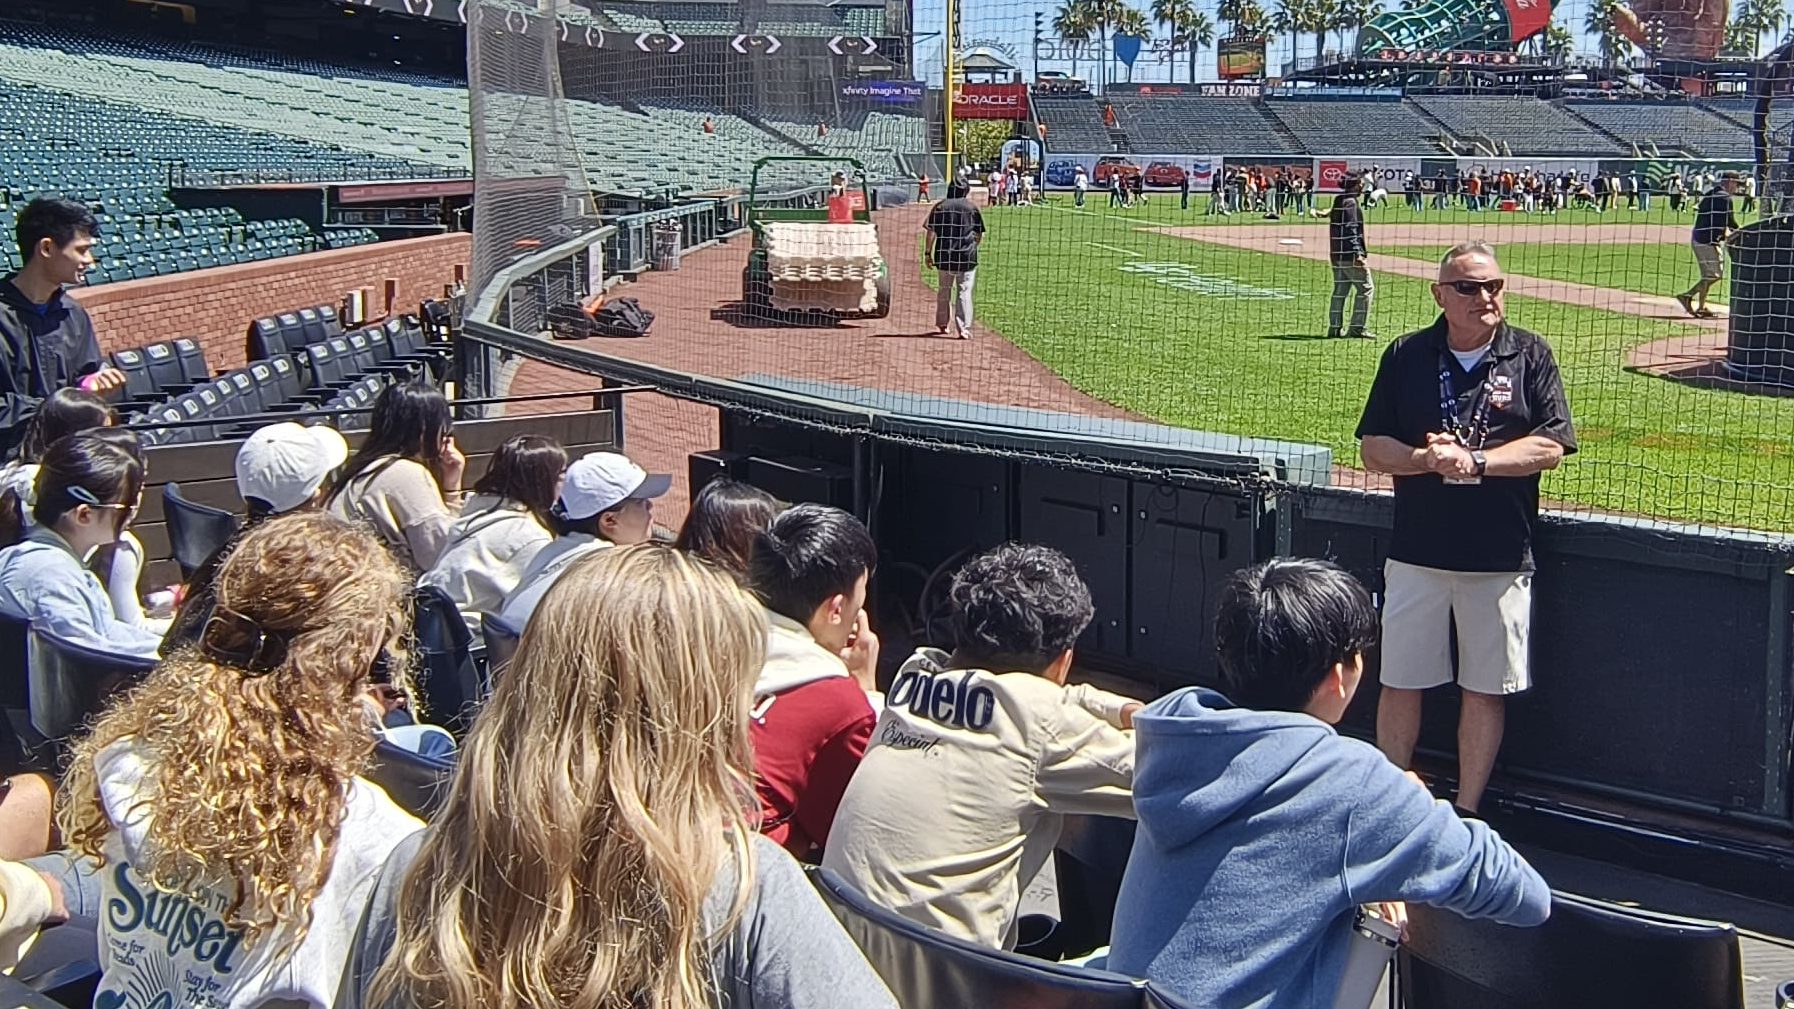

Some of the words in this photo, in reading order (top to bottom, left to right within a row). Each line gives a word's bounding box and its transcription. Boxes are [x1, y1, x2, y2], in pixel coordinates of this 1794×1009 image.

[842, 85, 868, 96] xfinity
[869, 86, 902, 97] Imagine
[903, 86, 921, 96] That
[1201, 85, 1226, 97] FAN
[1229, 85, 1260, 97] ZONE
[955, 94, 1018, 105] ORACLE
[108, 861, 244, 974] Sunset
